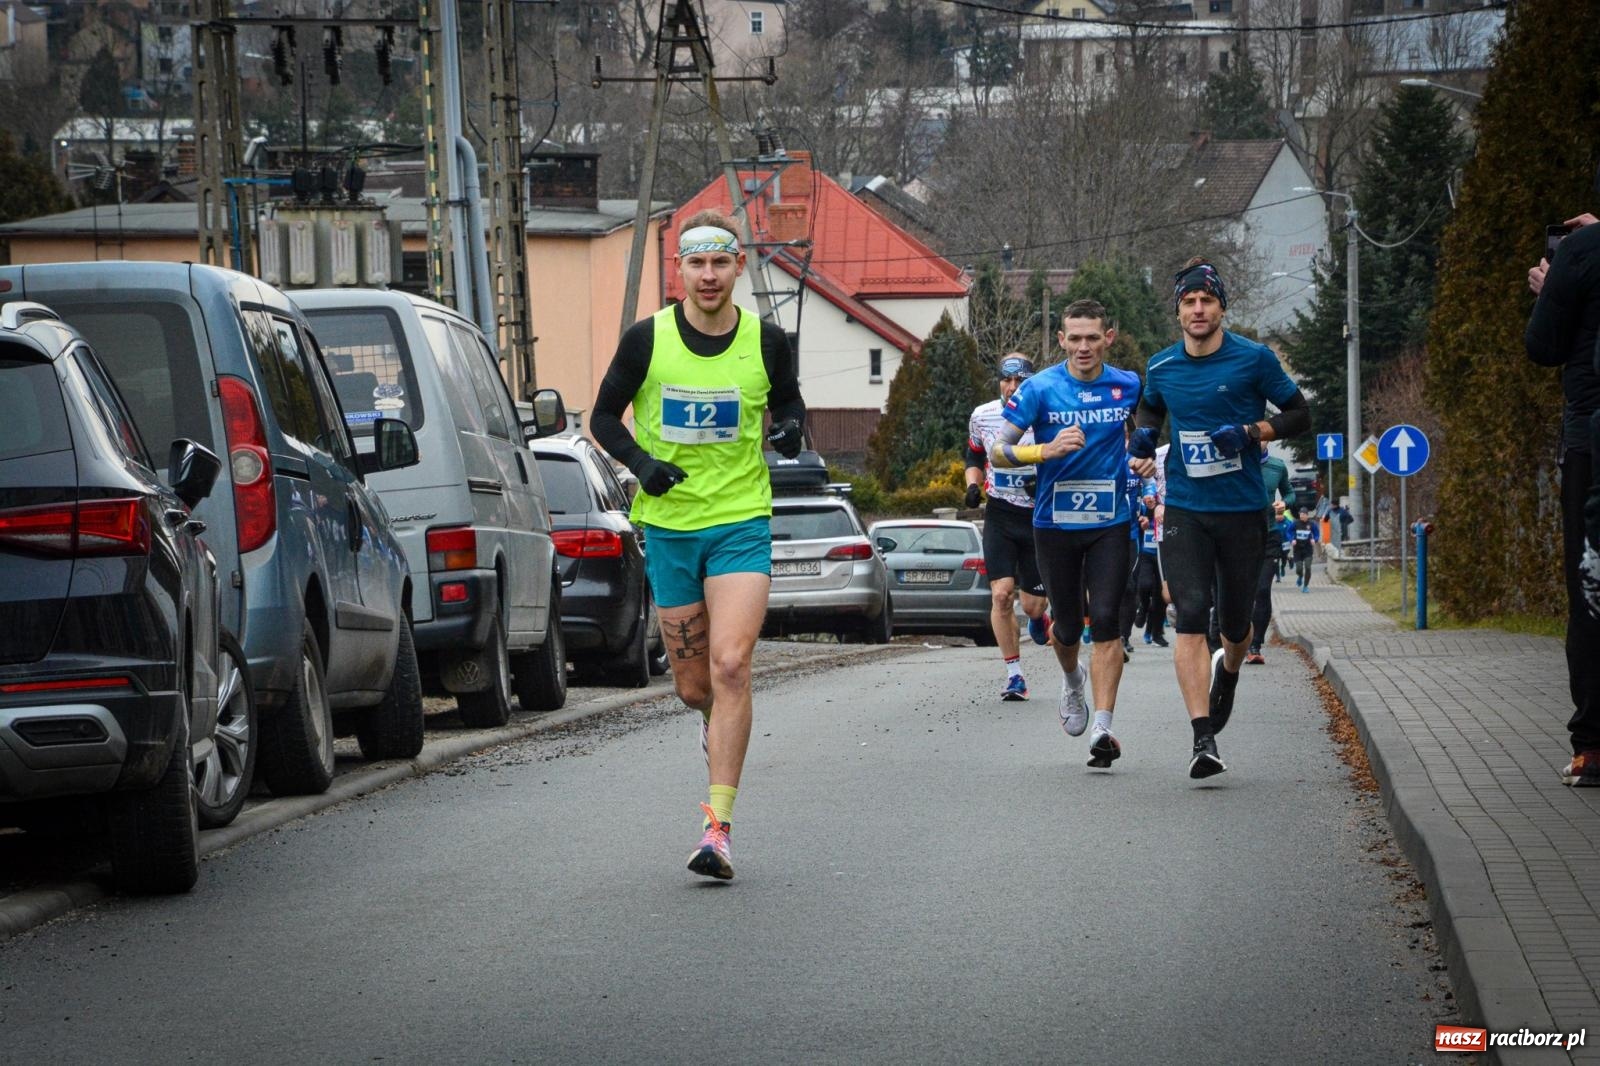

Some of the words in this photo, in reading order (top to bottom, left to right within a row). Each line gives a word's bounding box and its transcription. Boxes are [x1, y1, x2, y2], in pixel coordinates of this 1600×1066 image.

[683, 403, 717, 427] 12
[1047, 407, 1130, 425] RUNNERS
[1006, 475, 1025, 488] 16
[1071, 492, 1098, 511] 92
